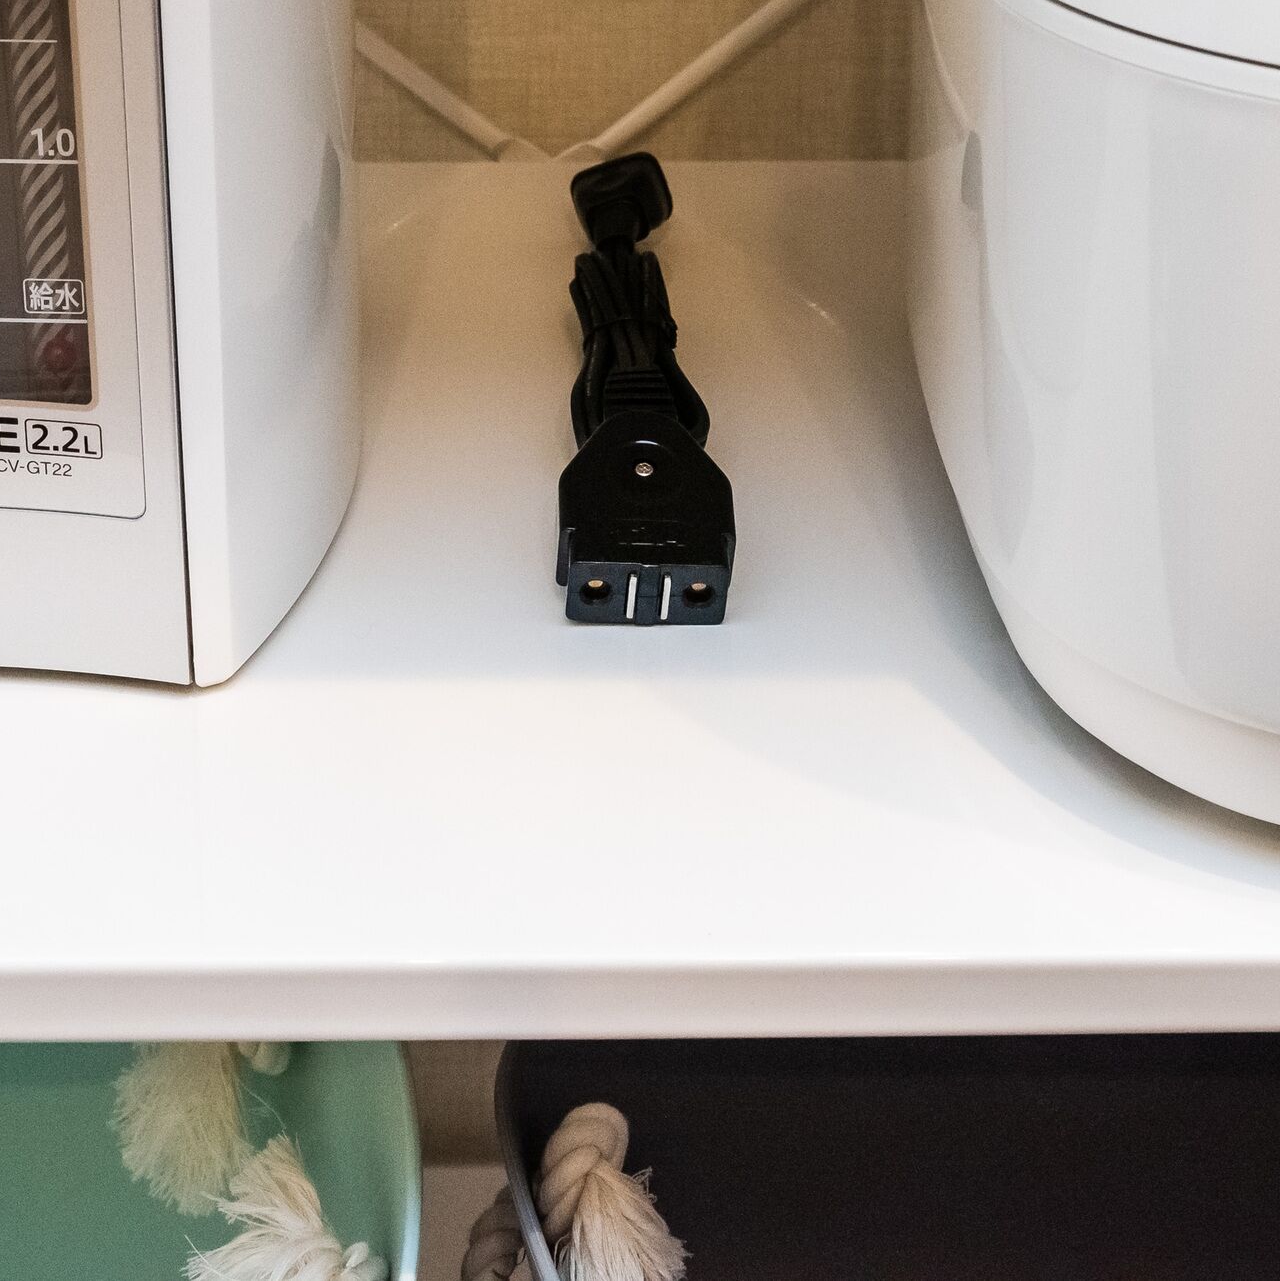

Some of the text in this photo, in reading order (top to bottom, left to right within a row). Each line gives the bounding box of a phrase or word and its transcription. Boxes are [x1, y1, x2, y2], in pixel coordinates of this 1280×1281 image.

[30, 128, 76, 159] 1.0
[29, 282, 80, 312] 給水
[30, 423, 97, 456] 2.2L
